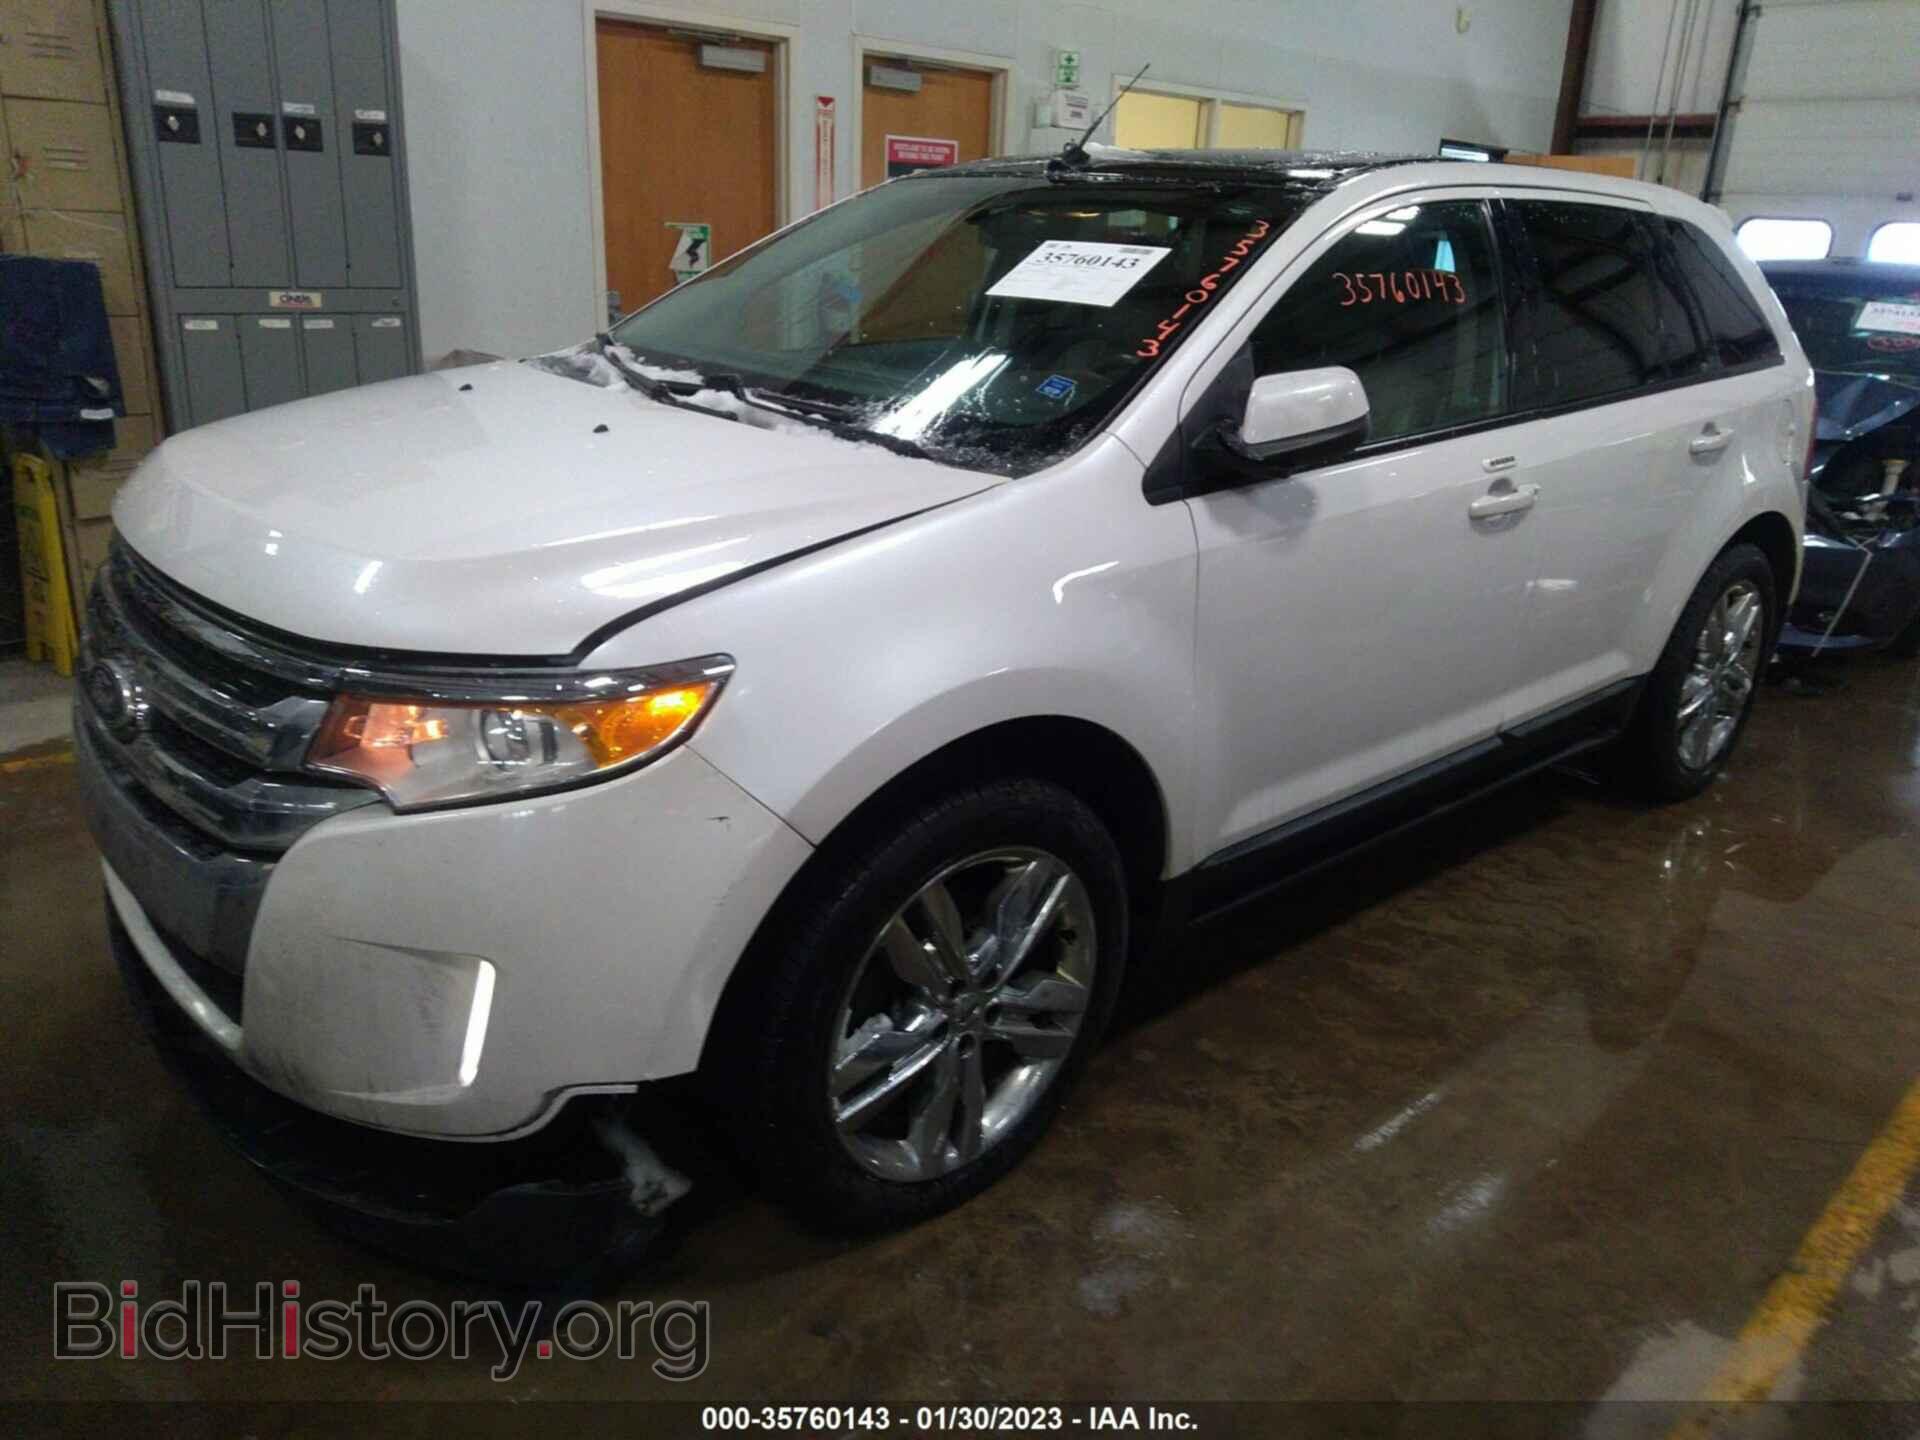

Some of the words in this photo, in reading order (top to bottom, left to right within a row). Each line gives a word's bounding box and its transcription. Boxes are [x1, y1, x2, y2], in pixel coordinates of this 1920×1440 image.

[1035, 251, 1141, 270] 35760143
[1136, 219, 1270, 358] 35760143
[1332, 271, 1467, 306] 35760143
